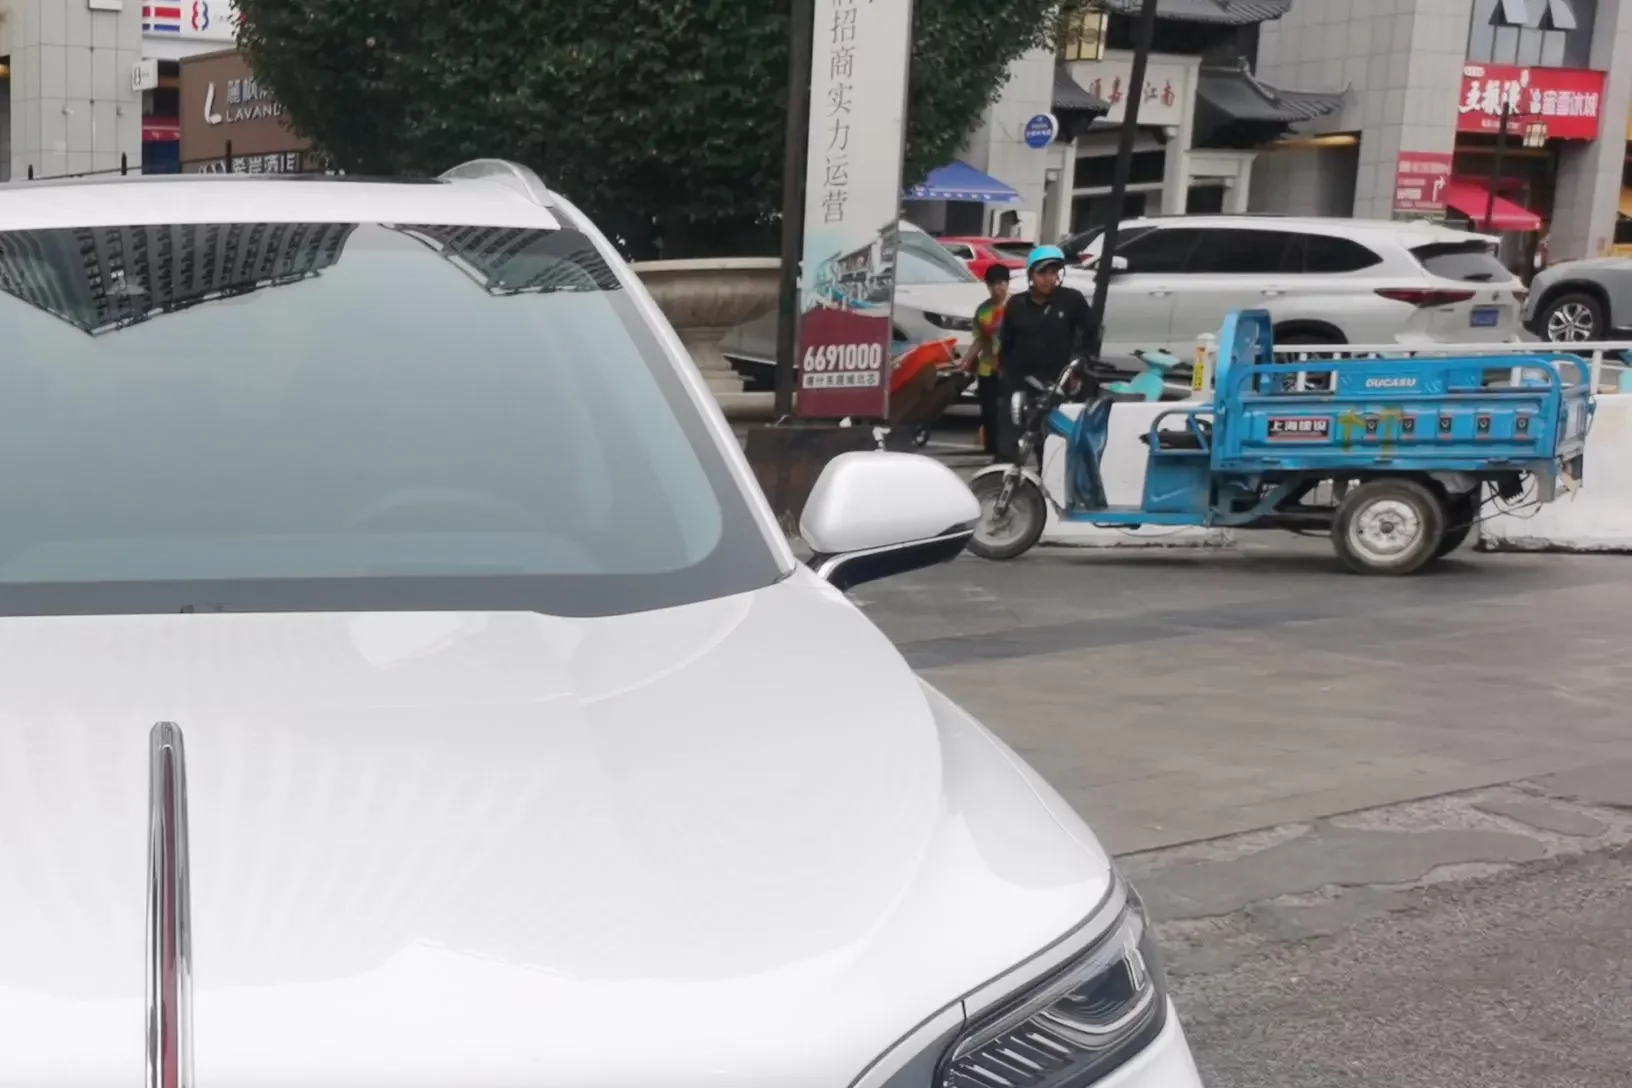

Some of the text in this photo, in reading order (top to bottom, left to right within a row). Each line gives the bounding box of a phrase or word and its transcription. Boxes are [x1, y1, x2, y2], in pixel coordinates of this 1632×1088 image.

[821, 0, 858, 224] 招商实力运营
[803, 343, 882, 371] 6691000
